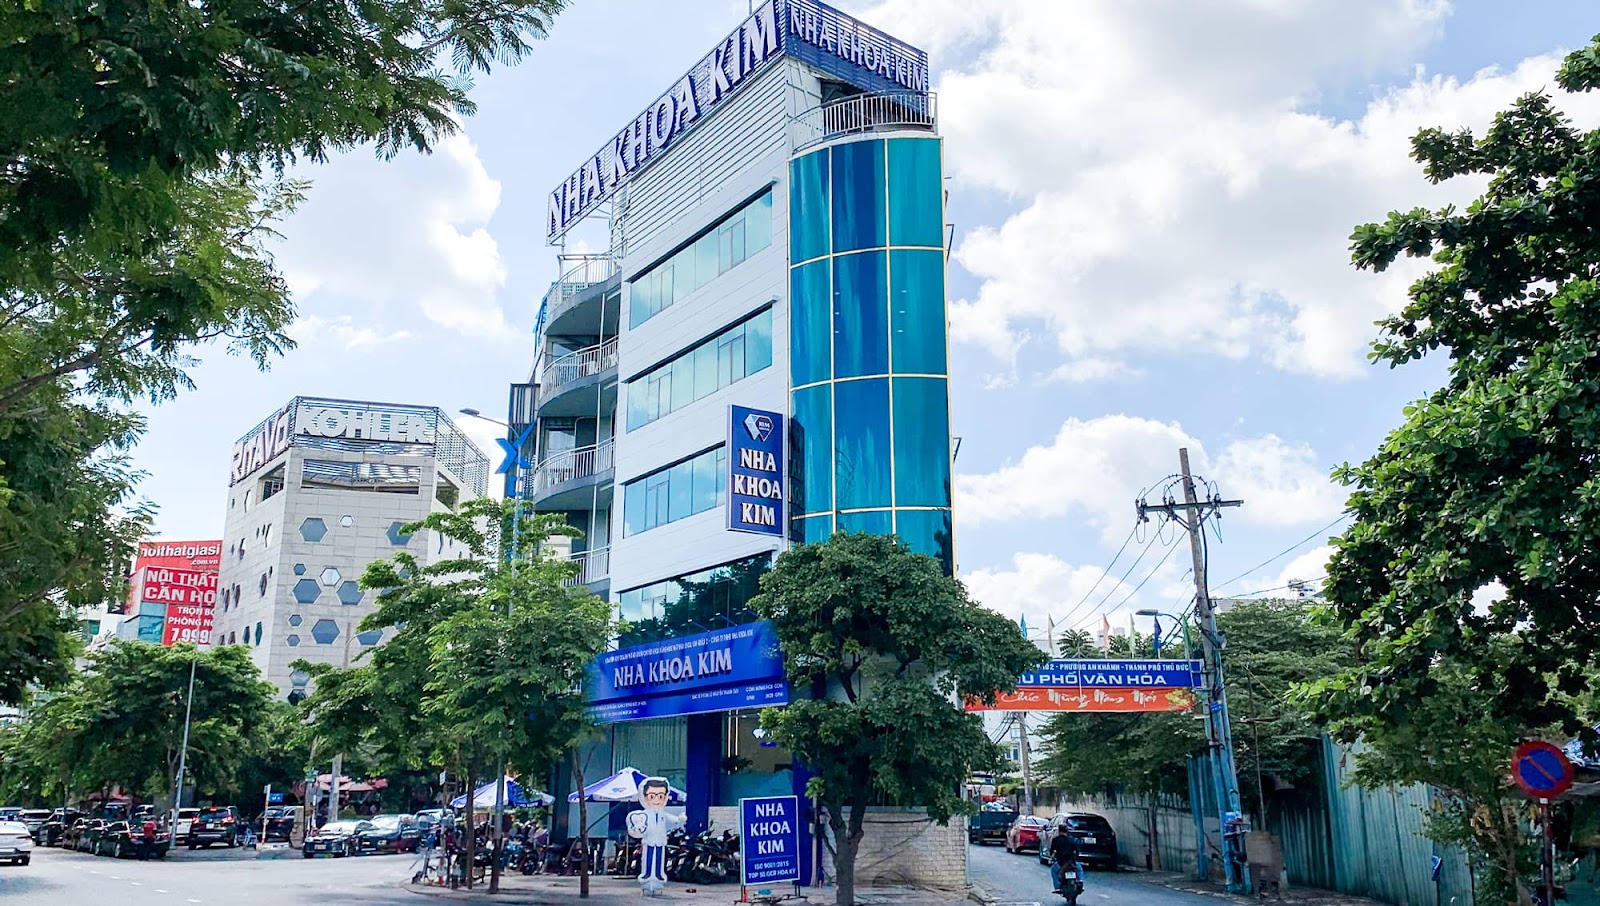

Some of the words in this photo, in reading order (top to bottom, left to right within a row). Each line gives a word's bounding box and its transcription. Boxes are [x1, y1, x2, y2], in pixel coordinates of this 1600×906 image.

[790, 9, 833, 52] NHA
[836, 29, 891, 79] KHOA
[895, 56, 927, 91] KIM
[550, 156, 602, 231] NHA
[610, 74, 700, 187] KHOA
[709, 3, 780, 104] KIM
[296, 406, 436, 444] KOHLER
[740, 448, 777, 471] NHA
[733, 474, 782, 499] KHOA
[741, 502, 776, 526] KIM
[141, 544, 220, 558] noithatgiasi
[146, 569, 174, 585] NỘI
[178, 572, 218, 587] THẤT
[144, 586, 185, 601] CĂN
[190, 590, 216, 606] HỘ
[171, 627, 211, 643] 7.999
[614, 665, 645, 688] NHA
[649, 655, 694, 682] KHOA
[698, 648, 732, 675] KIM
[1039, 671, 1078, 684] PHỐ
[1083, 672, 1122, 684] VĂN
[1127, 672, 1167, 685] HÓA
[755, 802, 785, 818] NHA
[750, 821, 791, 837] KHOA
[757, 839, 784, 855] KIM
